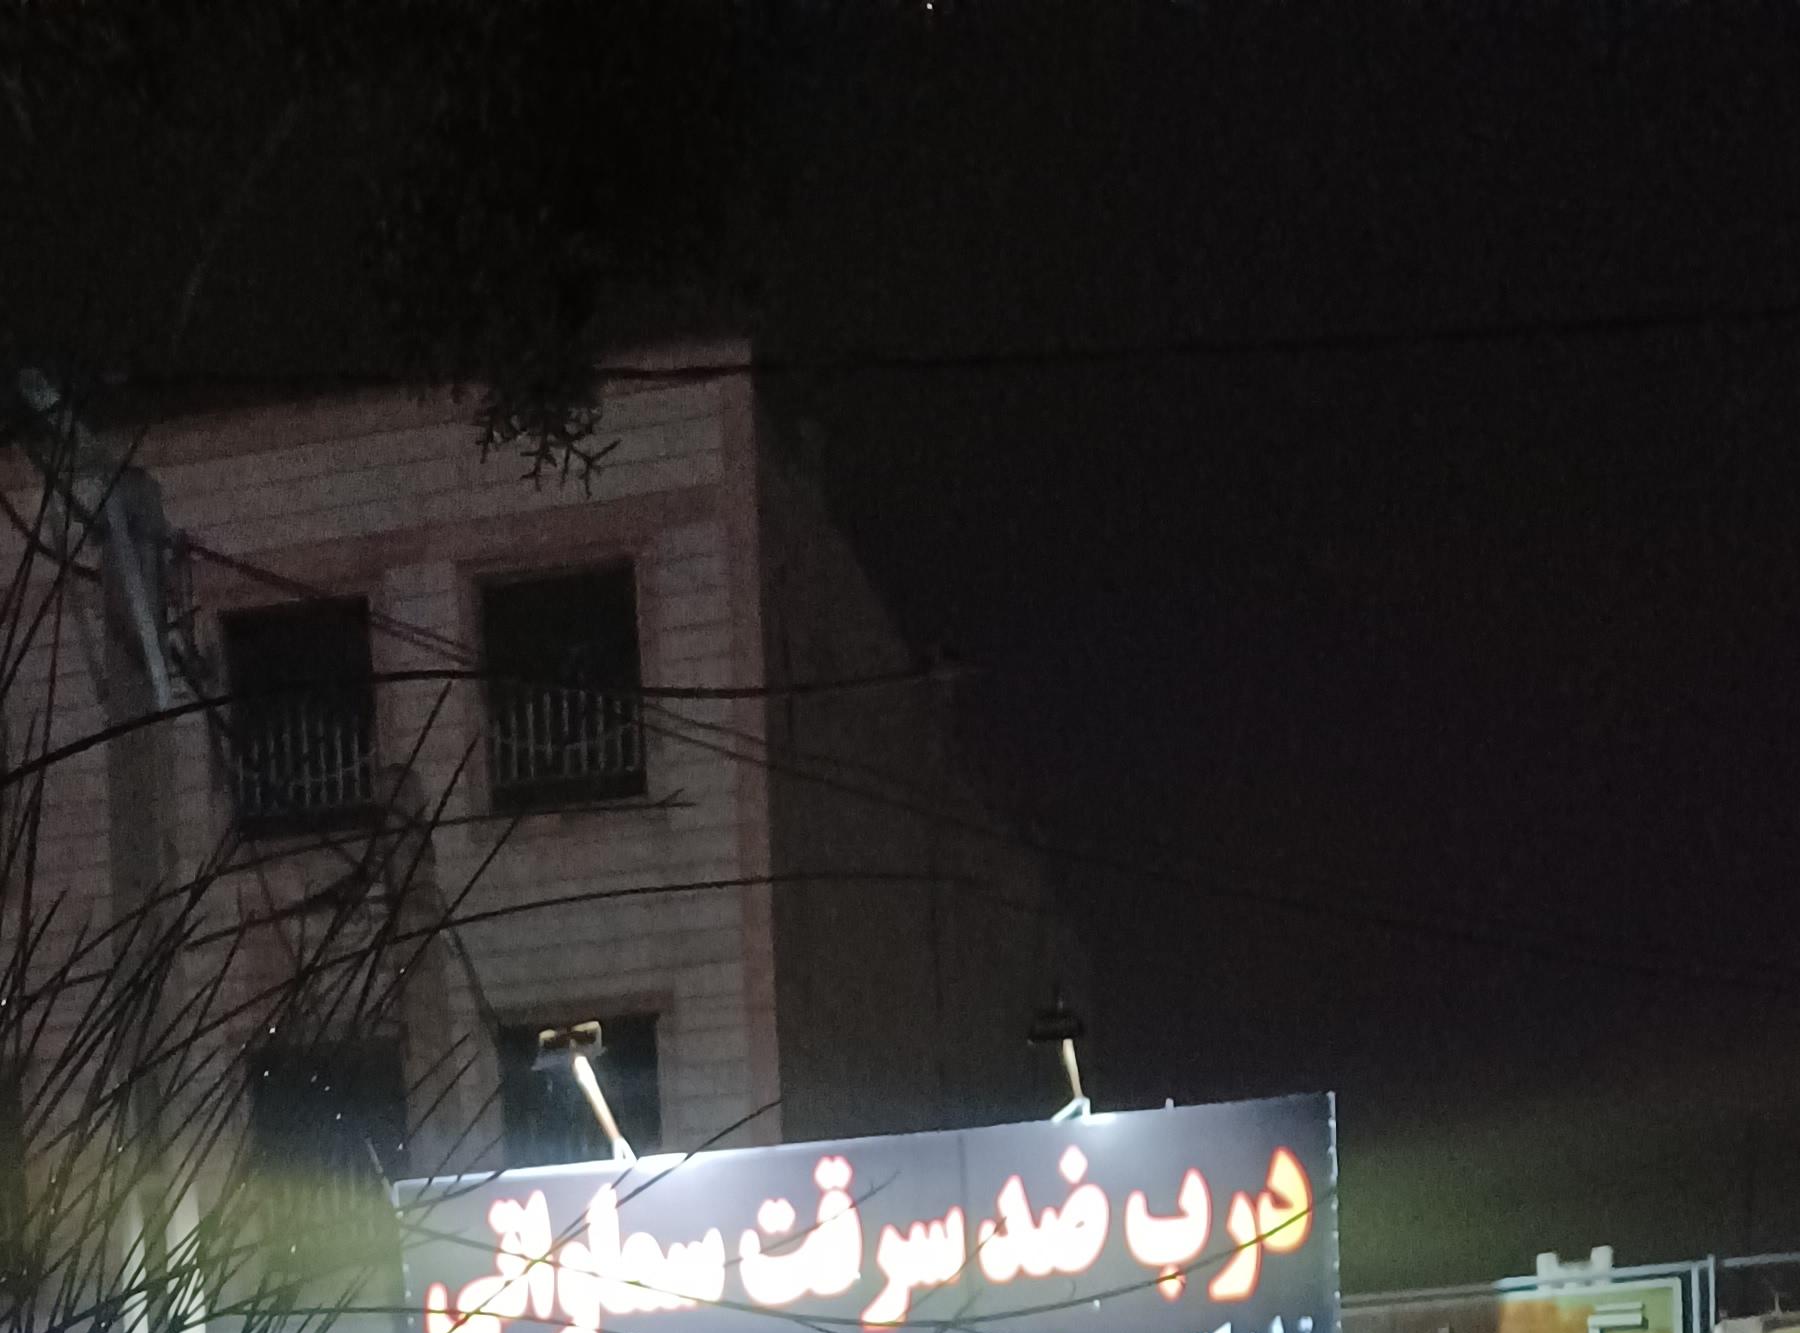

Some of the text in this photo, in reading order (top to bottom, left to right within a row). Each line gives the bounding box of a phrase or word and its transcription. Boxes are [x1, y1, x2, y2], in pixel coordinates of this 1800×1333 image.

[738, 1155, 967, 1333] سرقت
[977, 1144, 1110, 1283] ضد
[1123, 1145, 1312, 1302] درب
